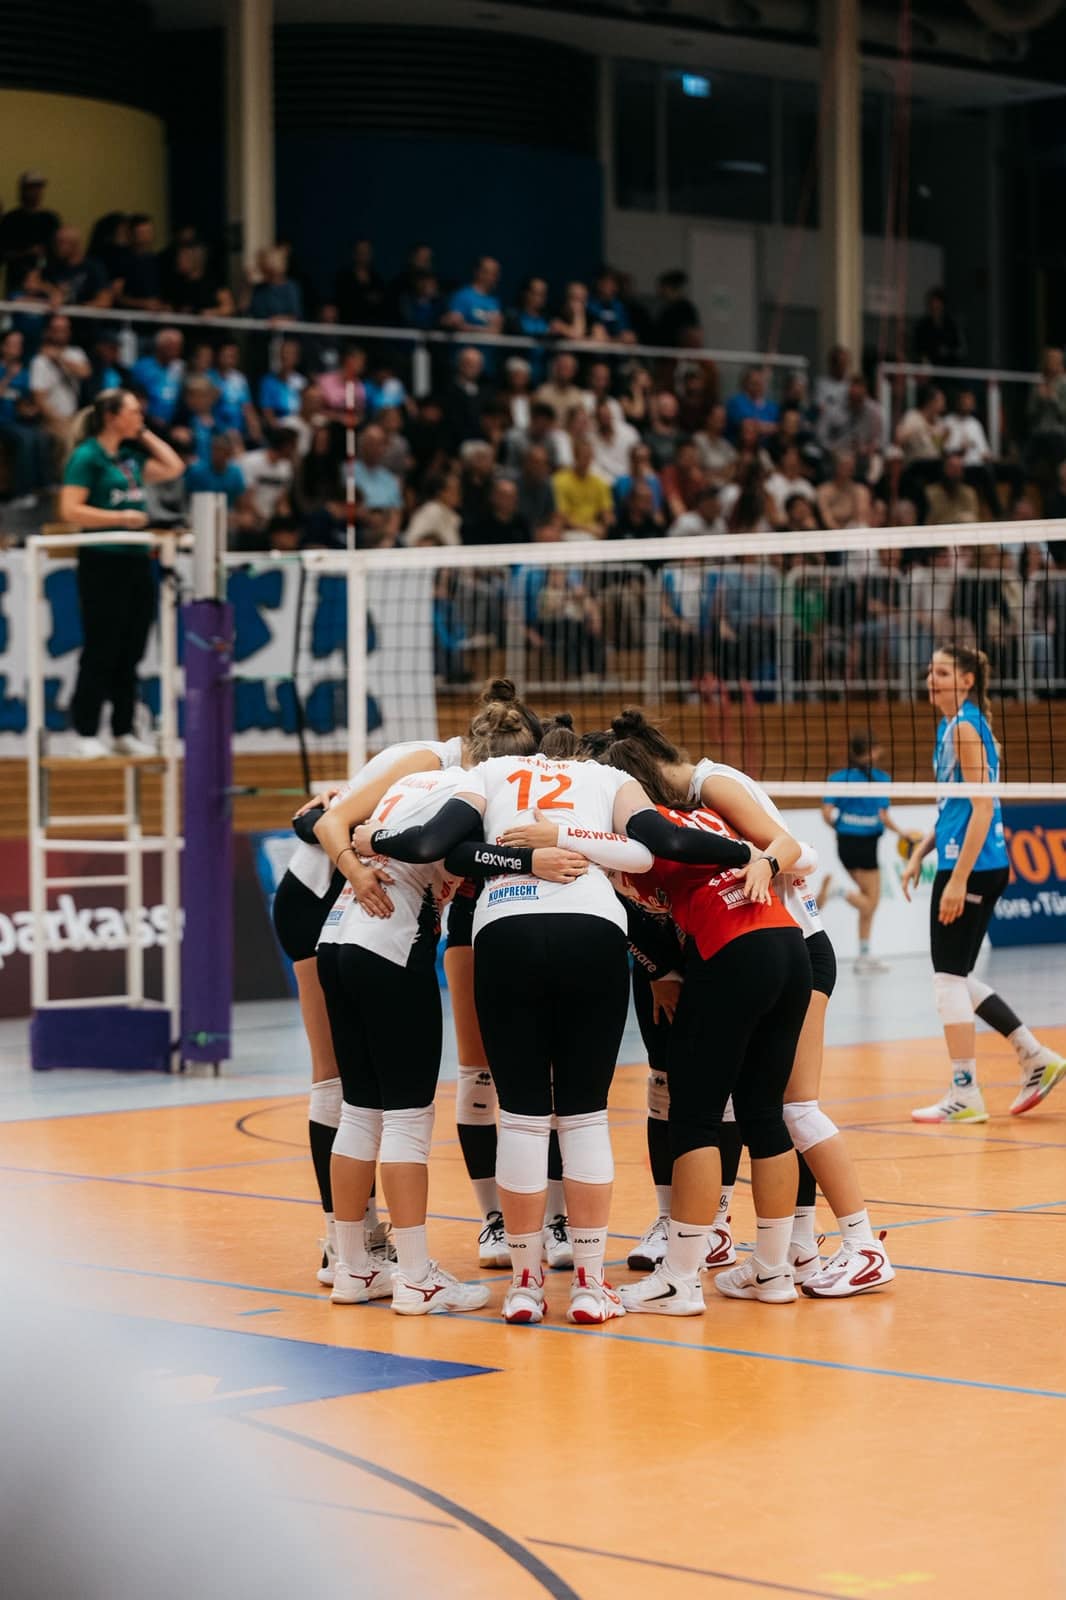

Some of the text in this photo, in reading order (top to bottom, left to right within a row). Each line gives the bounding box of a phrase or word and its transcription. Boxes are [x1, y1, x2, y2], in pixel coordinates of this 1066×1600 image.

[506, 769, 575, 811] 12
[567, 827, 628, 843] Lexware
[489, 885, 538, 901] KONPRECHT
[0, 894, 186, 968] parkass
[628, 943, 657, 973] ware
